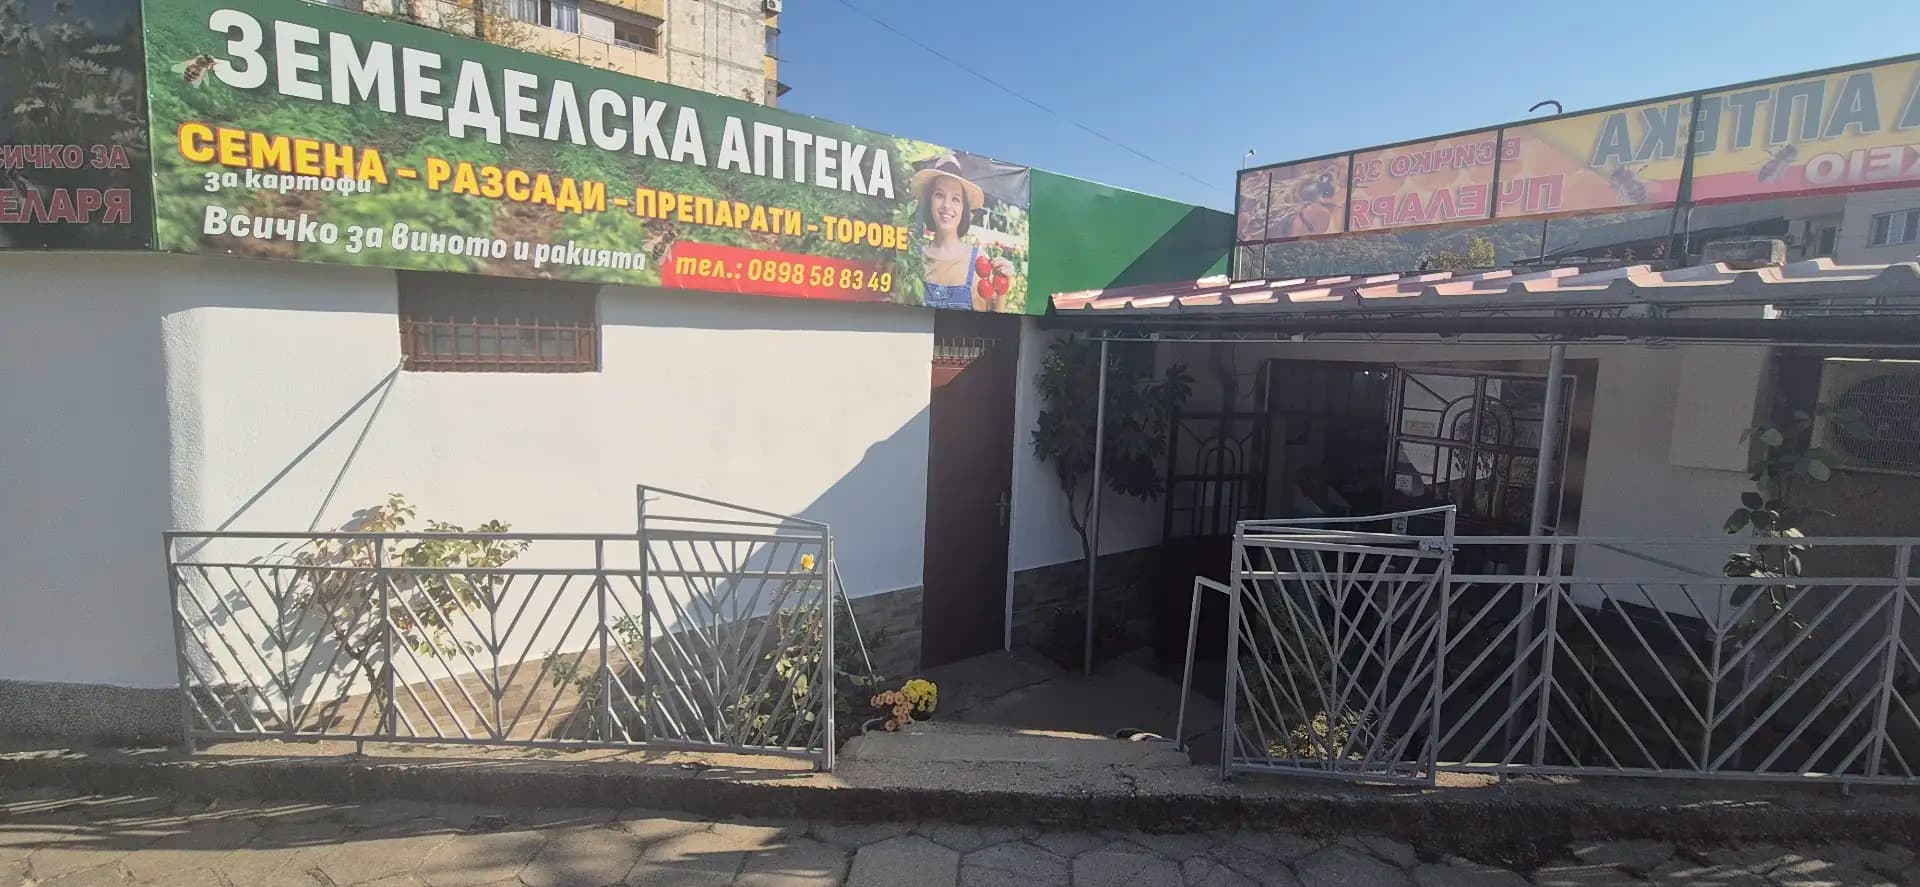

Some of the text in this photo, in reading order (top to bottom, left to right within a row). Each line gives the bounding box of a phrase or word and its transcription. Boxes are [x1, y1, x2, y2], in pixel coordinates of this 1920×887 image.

[208, 8, 896, 199] ЗЕМЕДЕЛСКА АПТЕКА
[0, 144, 130, 169] ИЧКО ЗА
[179, 121, 388, 184] СЕМЕНА
[426, 157, 607, 215] РАЗСАДИ
[636, 187, 803, 237] ПРЕПАРАТИ
[823, 215, 909, 251] ТОРОВЕ
[204, 168, 372, 197] за картофи
[0, 188, 131, 224] ЕЛАРЯ
[203, 205, 646, 271] Всичко за виното и ракията
[675, 254, 892, 293] тел.: 0898 58 83 49
